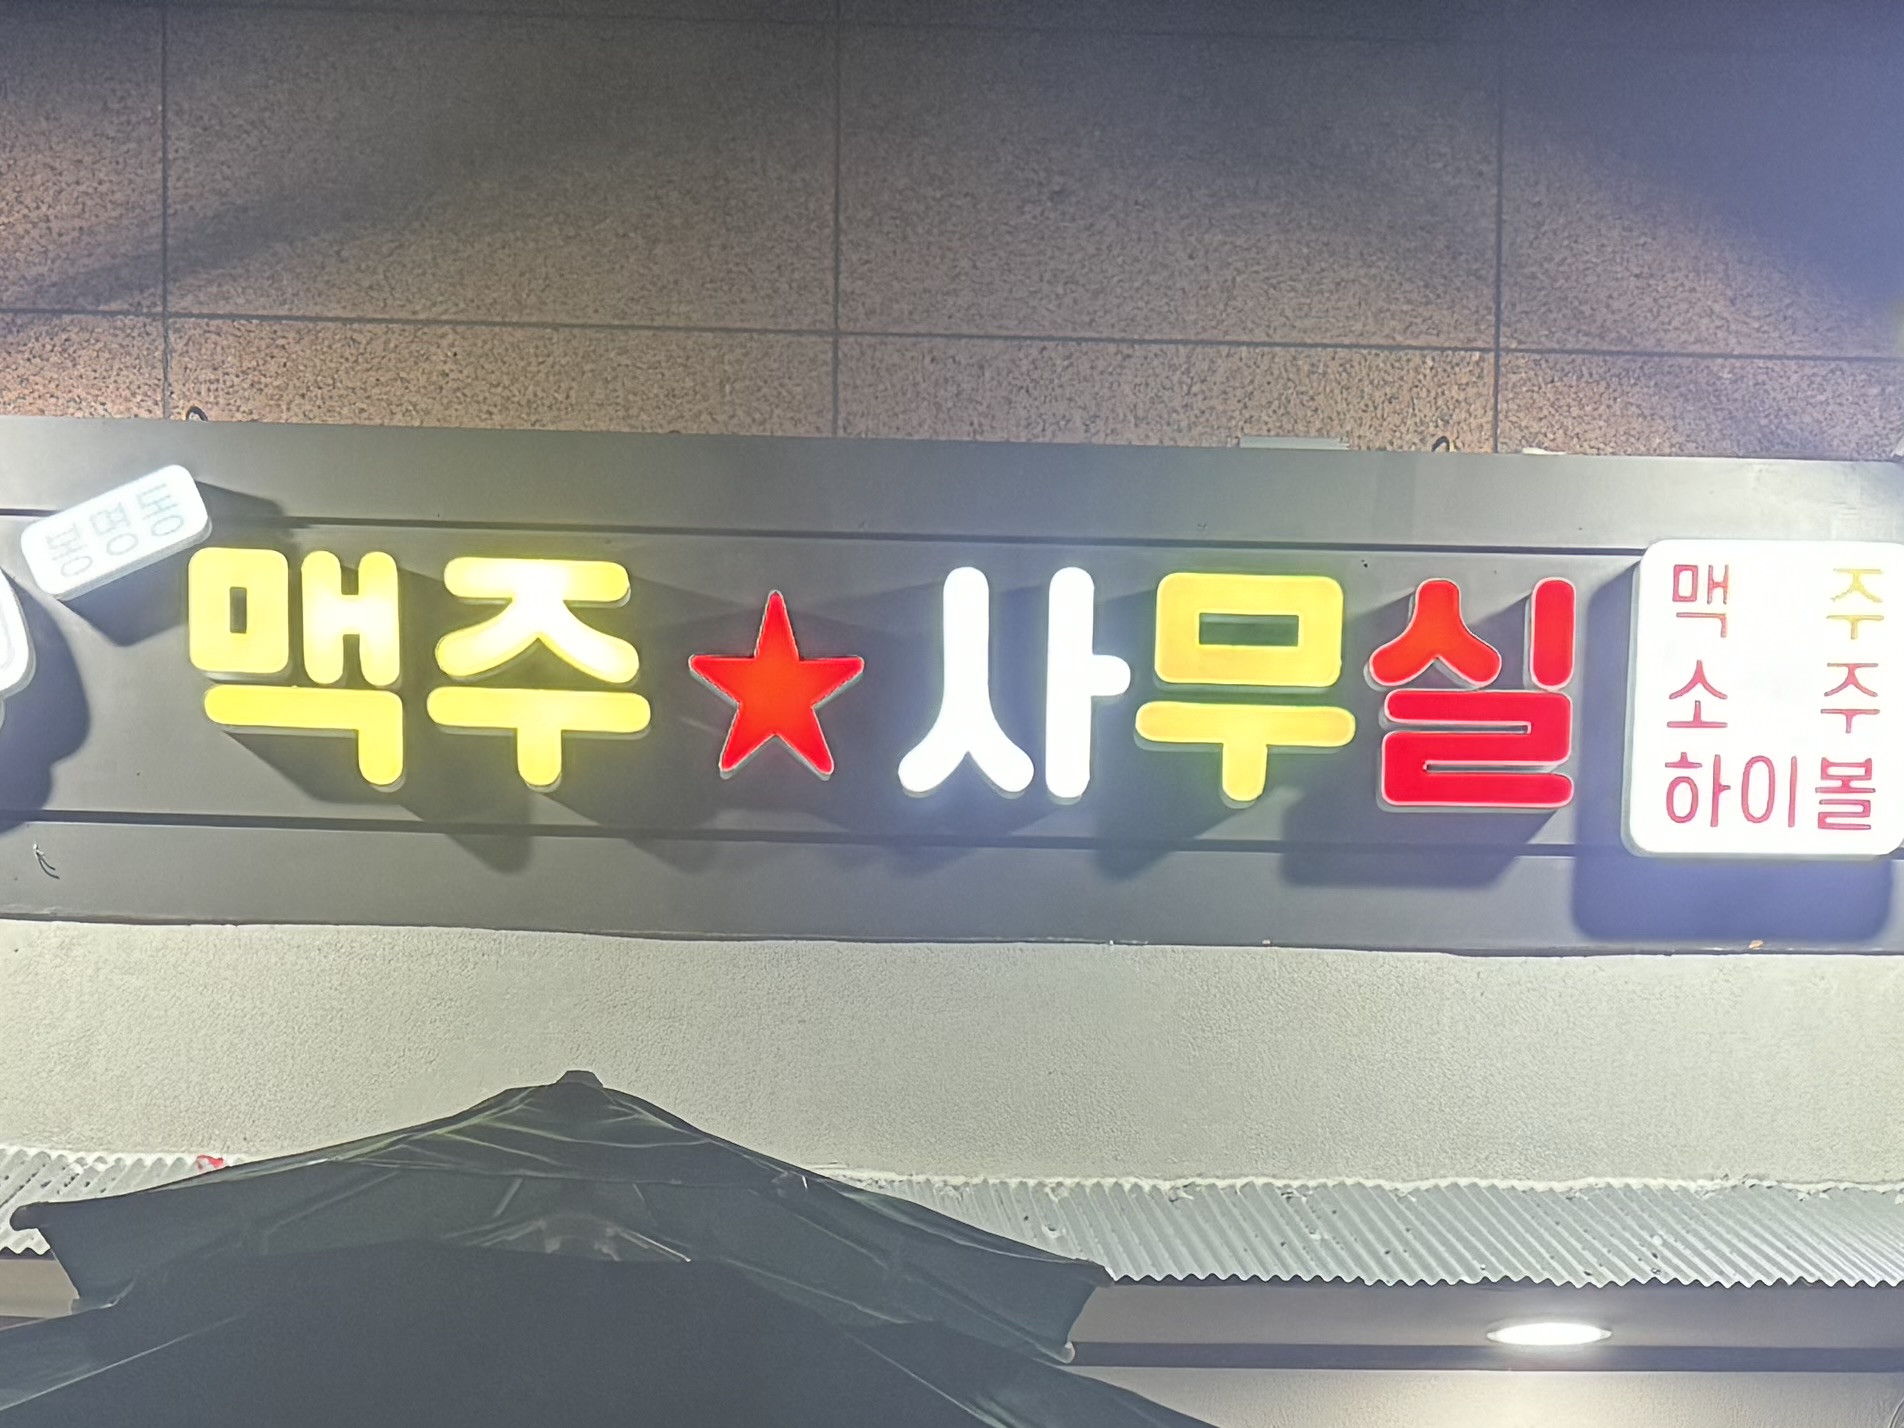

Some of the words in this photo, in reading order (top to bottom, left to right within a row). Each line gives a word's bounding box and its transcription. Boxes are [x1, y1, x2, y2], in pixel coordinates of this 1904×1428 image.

[186, 545, 653, 790] 맥주
[895, 566, 1577, 809] 사무실
[1664, 752, 1876, 831] 하이볼
